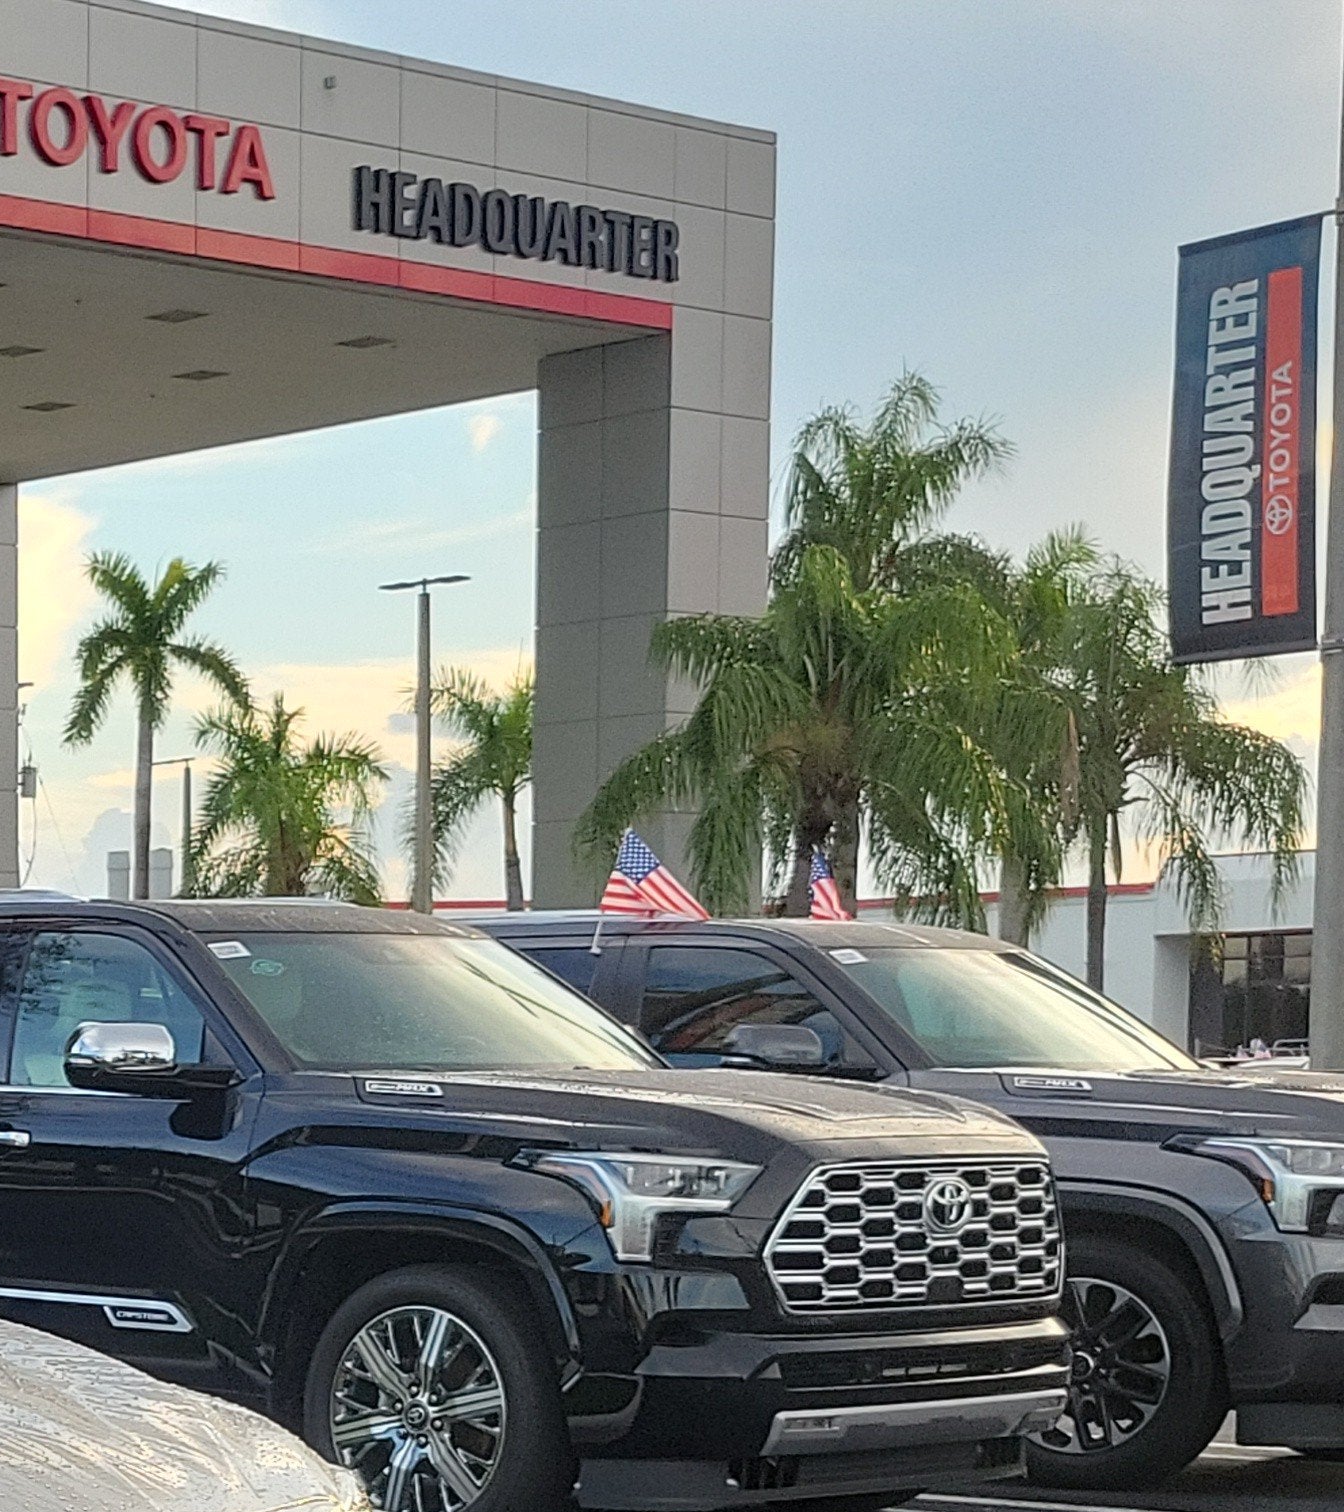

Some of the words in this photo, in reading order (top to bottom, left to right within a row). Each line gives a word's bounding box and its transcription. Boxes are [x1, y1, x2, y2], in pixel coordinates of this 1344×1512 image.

[352, 165, 679, 282] HEADQUARTER
[1201, 278, 1261, 625] HEADQUARTER
[1268, 361, 1293, 489] TOYOTA
